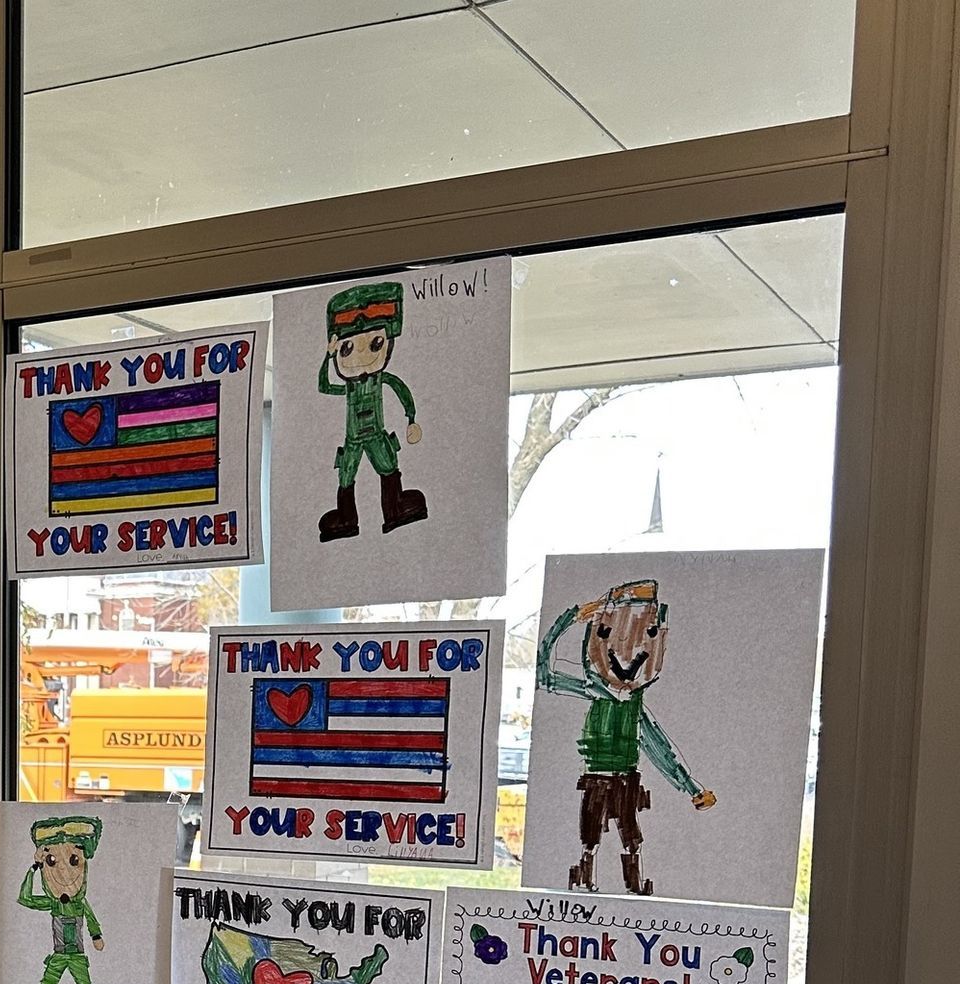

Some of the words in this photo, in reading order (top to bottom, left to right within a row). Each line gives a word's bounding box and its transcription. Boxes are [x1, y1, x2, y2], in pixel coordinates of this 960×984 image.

[19, 360, 111, 398] THANK
[120, 349, 186, 386] YOU
[193, 340, 250, 377] FOR
[27, 523, 109, 557] YOUR
[117, 511, 237, 552] SERVICE!
[223, 639, 322, 673] THANK
[333, 640, 408, 672] YOU
[419, 639, 483, 672] FOR
[106, 732, 202, 747] ASPLUND
[225, 806, 315, 838] YOUR
[324, 809, 466, 848] SERVICE!
[174, 887, 272, 927] THANK
[282, 898, 355, 934] YOU
[364, 905, 427, 943] FOR
[518, 922, 617, 962] Thank
[635, 932, 701, 970] You
